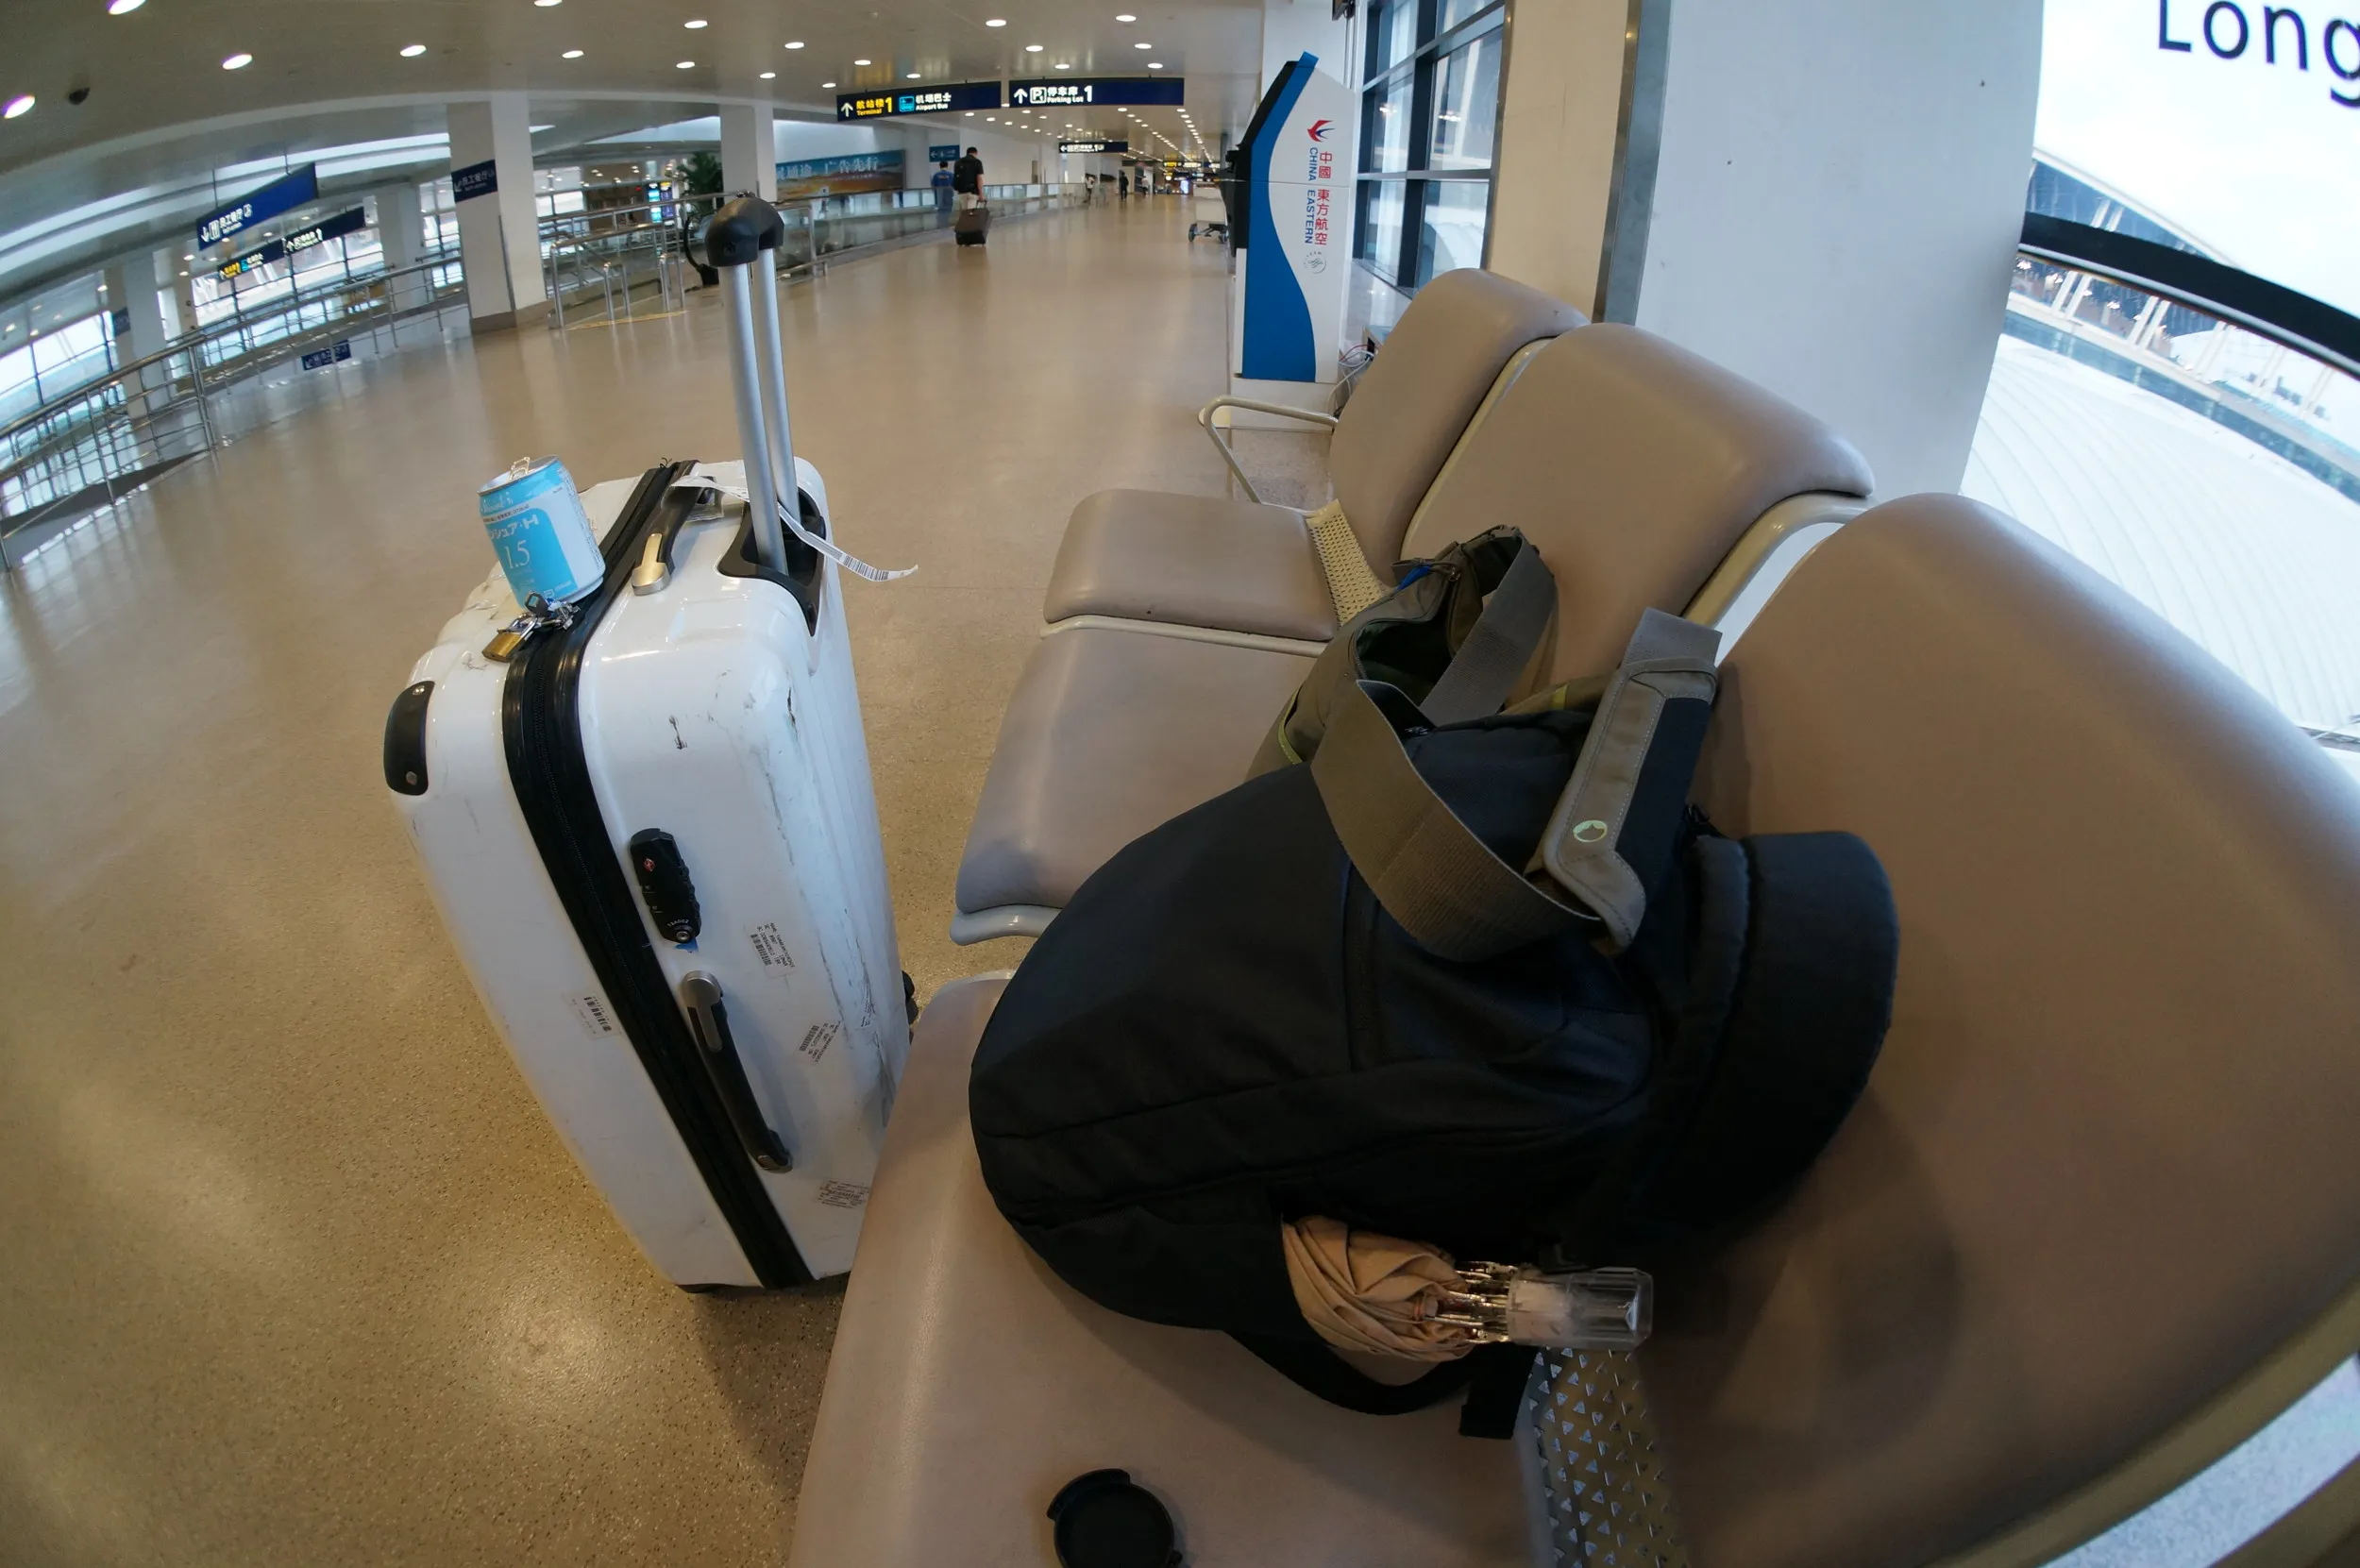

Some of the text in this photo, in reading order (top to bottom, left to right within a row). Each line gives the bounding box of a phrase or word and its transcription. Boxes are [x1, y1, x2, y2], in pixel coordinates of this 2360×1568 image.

[885, 96, 892, 113] 1
[916, 93, 952, 104] 机场巴士
[1084, 85, 1092, 102] 1
[916, 103, 936, 111] Airport
[1307, 146, 1319, 181] CHINA
[1314, 151, 1332, 245] 中國 東方航空
[1305, 189, 1315, 244] EASTERN
[505, 540, 531, 568] 1.5
